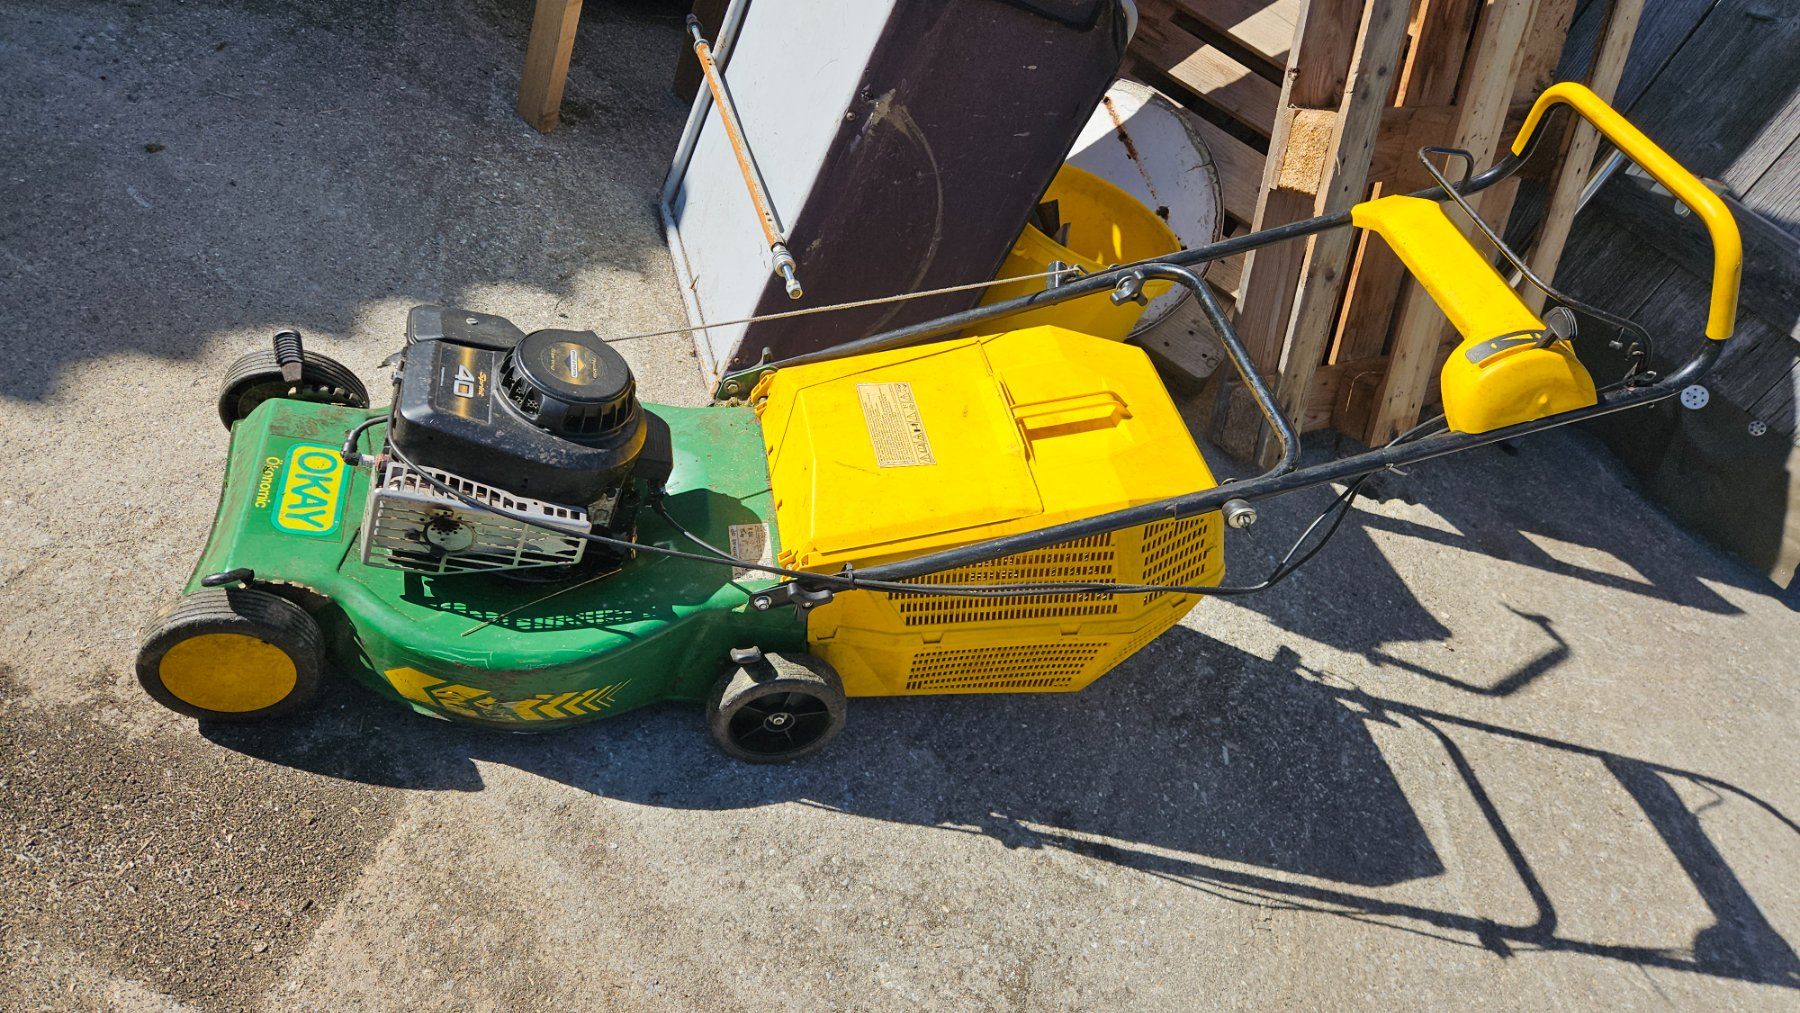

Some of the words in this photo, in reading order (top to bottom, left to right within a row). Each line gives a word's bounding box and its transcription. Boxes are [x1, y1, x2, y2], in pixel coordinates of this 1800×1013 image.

[454, 365, 475, 398] 40
[478, 371, 487, 397] Sprint
[255, 456, 283, 508] Ökonomic
[285, 451, 339, 528] OKAY
